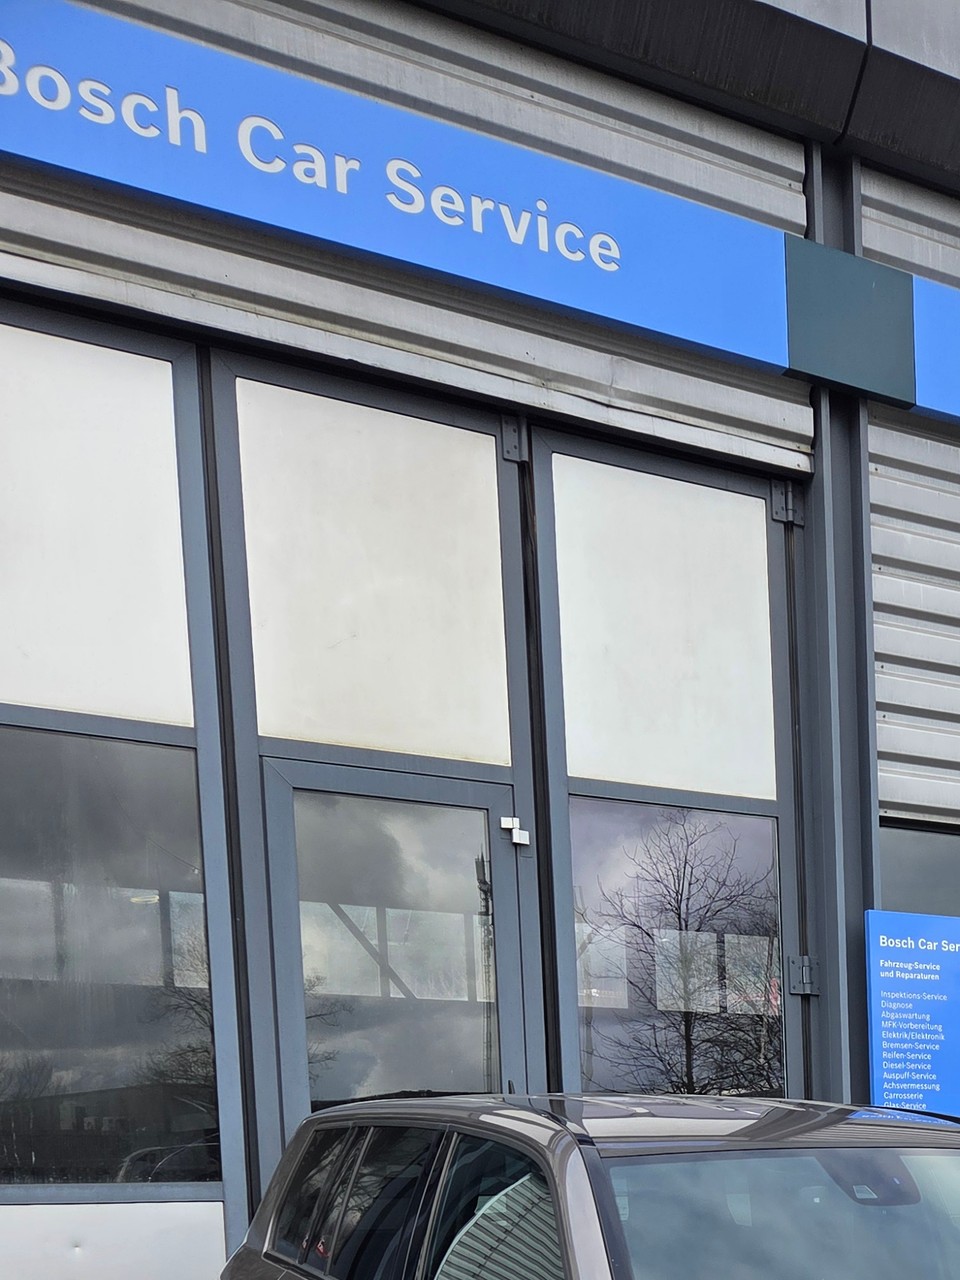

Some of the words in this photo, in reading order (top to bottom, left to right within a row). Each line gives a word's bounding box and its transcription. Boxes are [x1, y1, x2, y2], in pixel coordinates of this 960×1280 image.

[238, 115, 361, 194] Car
[386, 158, 622, 272] Service
[879, 935, 915, 949] Bosch
[919, 937, 938, 950] Car
[880, 960, 940, 970] Fahrzeug-Service
[880, 970, 894, 978] und
[896, 971, 939, 981] Reparaturen
[881, 991, 947, 1001] Inspektions-Service
[881, 1001, 913, 1010] Diagnose
[881, 1012, 930, 1021] Abgaswartung
[882, 1021, 943, 1032] MFK-Vorbereitung
[882, 1031, 945, 1041] Elektrik/Elektronik
[882, 1041, 940, 1051] Bremsen-Service
[882, 1051, 931, 1060] Reifen-Service
[883, 1061, 931, 1070] Diesel-Service
[883, 1072, 936, 1080] Auspuff-Service
[883, 1081, 940, 1091] Achsvermessung
[884, 1091, 923, 1100] Carrosserie
